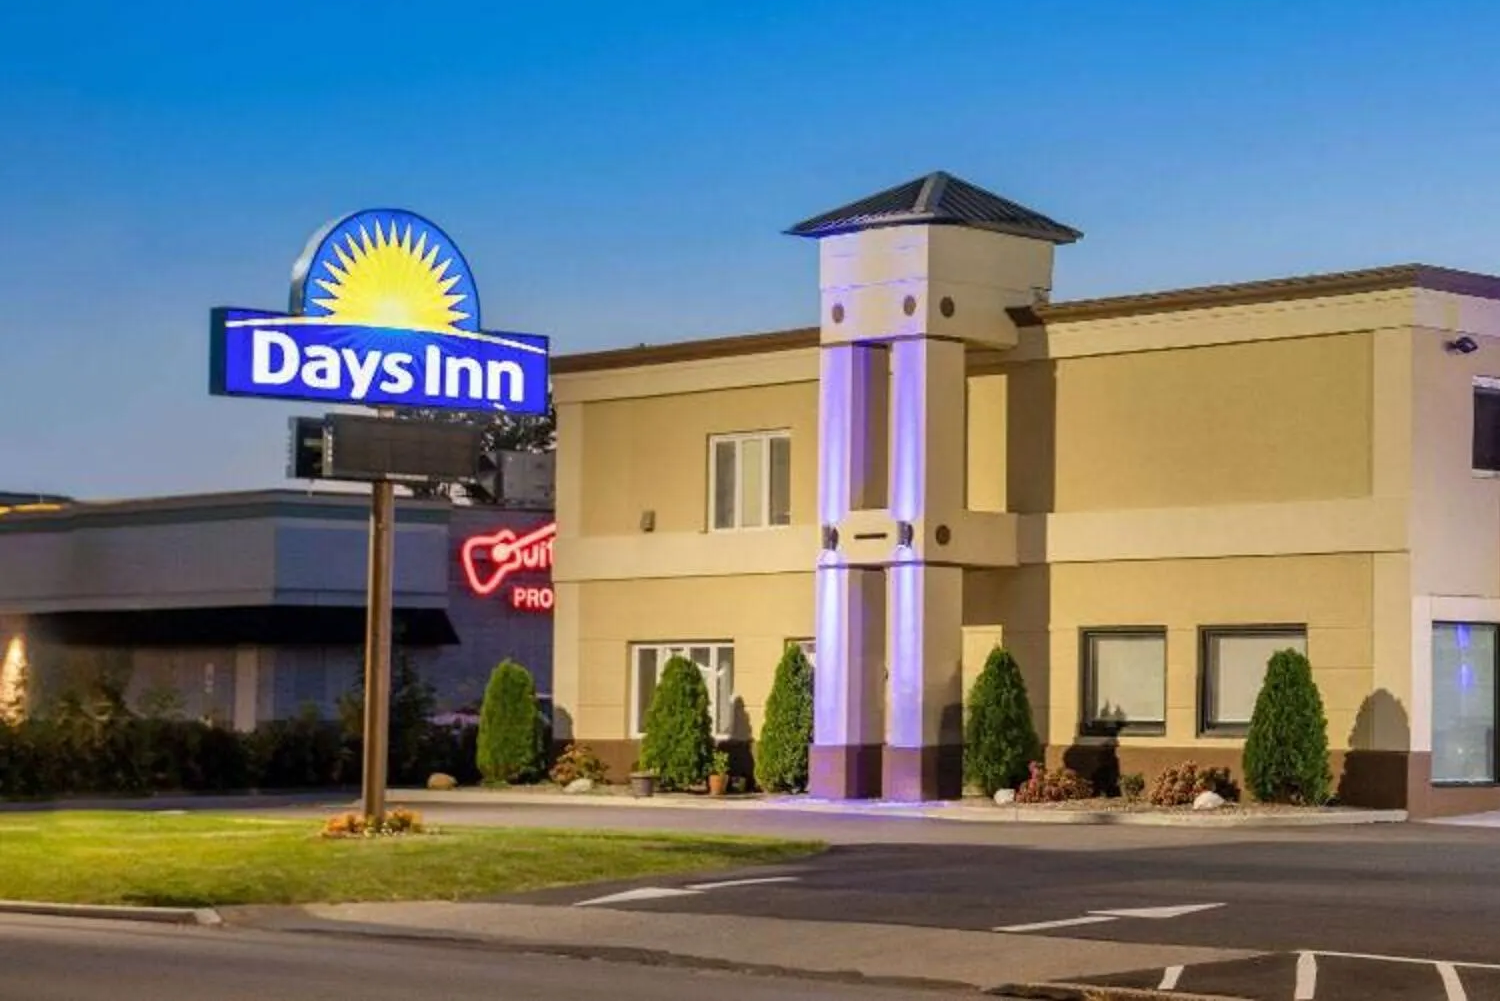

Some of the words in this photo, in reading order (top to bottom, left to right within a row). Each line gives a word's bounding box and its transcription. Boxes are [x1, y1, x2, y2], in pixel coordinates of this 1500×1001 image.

[251, 329, 415, 400] Days
[424, 343, 525, 402] Inn
[513, 587, 553, 609] PRO
